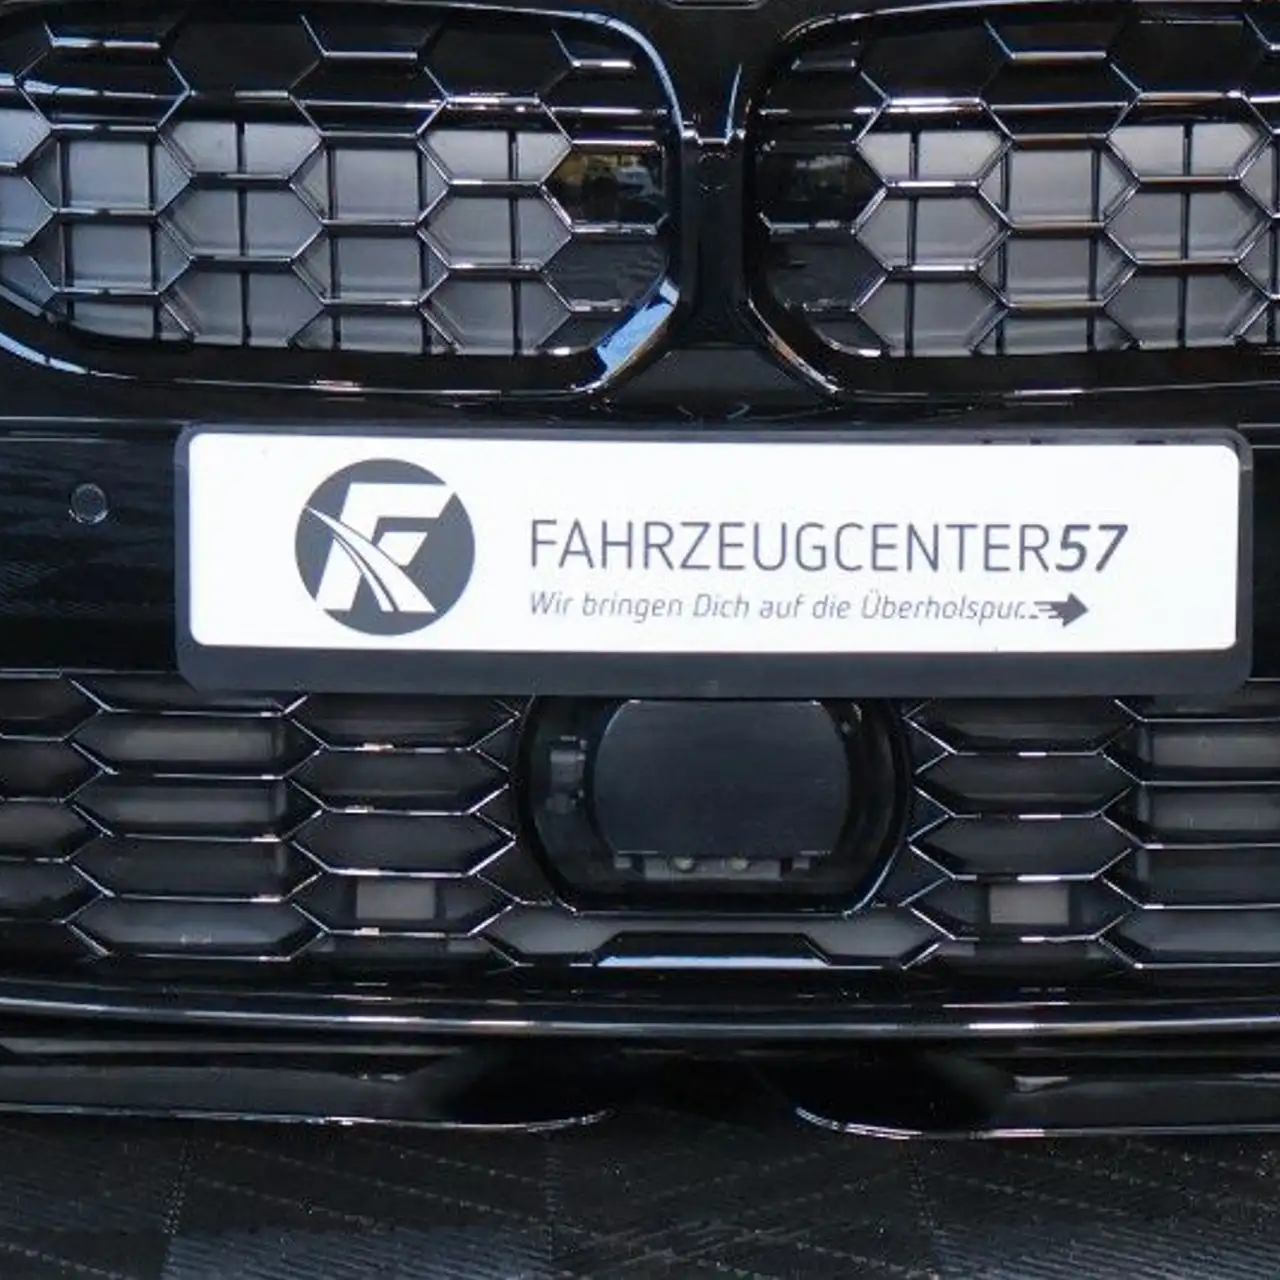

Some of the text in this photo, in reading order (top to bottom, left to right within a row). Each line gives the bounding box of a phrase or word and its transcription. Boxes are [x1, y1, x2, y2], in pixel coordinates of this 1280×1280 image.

[531, 518, 1129, 574] FAHRZEUGCENTER57
[531, 591, 573, 618] Wir
[582, 592, 683, 624] bringen
[692, 592, 751, 619] Dich
[759, 593, 804, 620] auf
[813, 593, 852, 619] die
